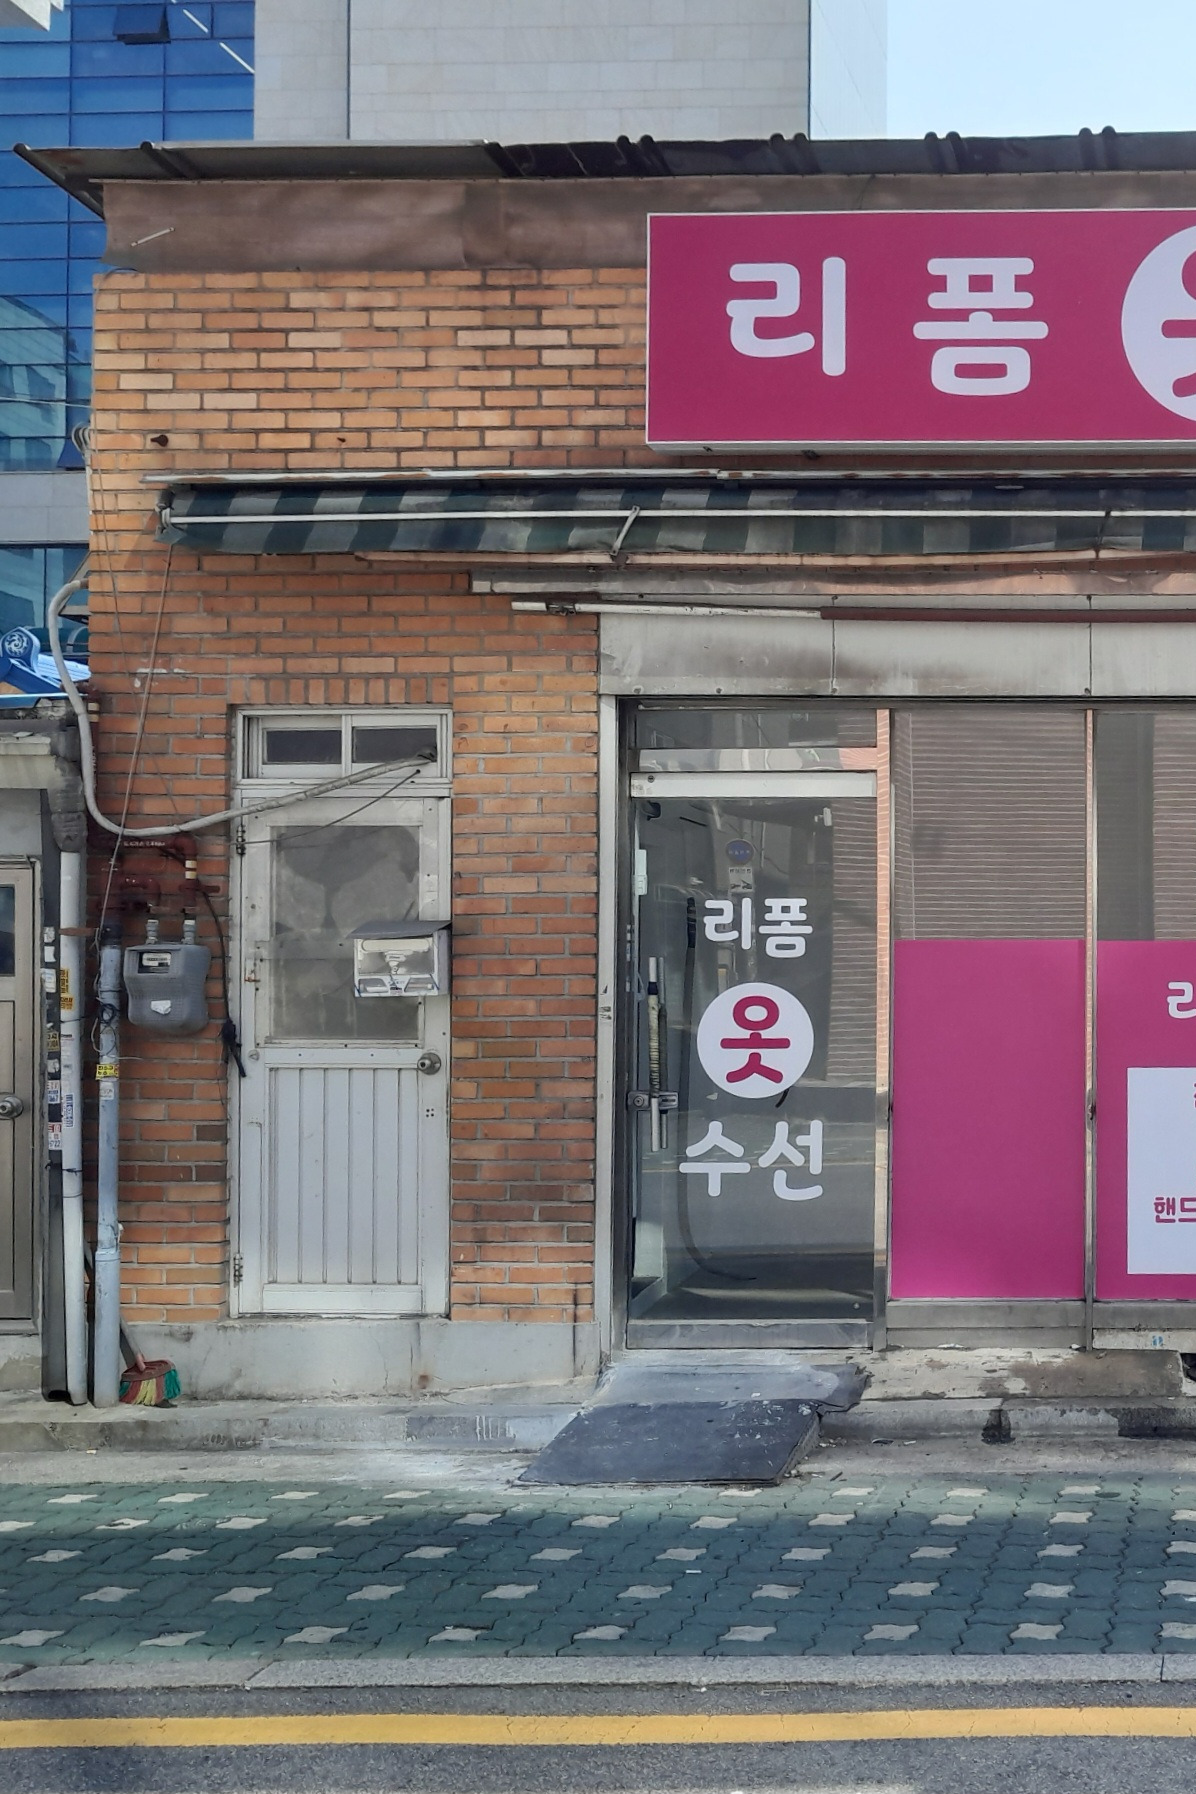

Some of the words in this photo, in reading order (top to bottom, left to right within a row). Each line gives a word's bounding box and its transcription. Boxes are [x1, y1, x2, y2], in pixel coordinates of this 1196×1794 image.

[726, 256, 1049, 396] 리폼
[704, 897, 814, 958] 리폼
[720, 995, 791, 1083] 옷
[679, 1120, 824, 1201] 수선
